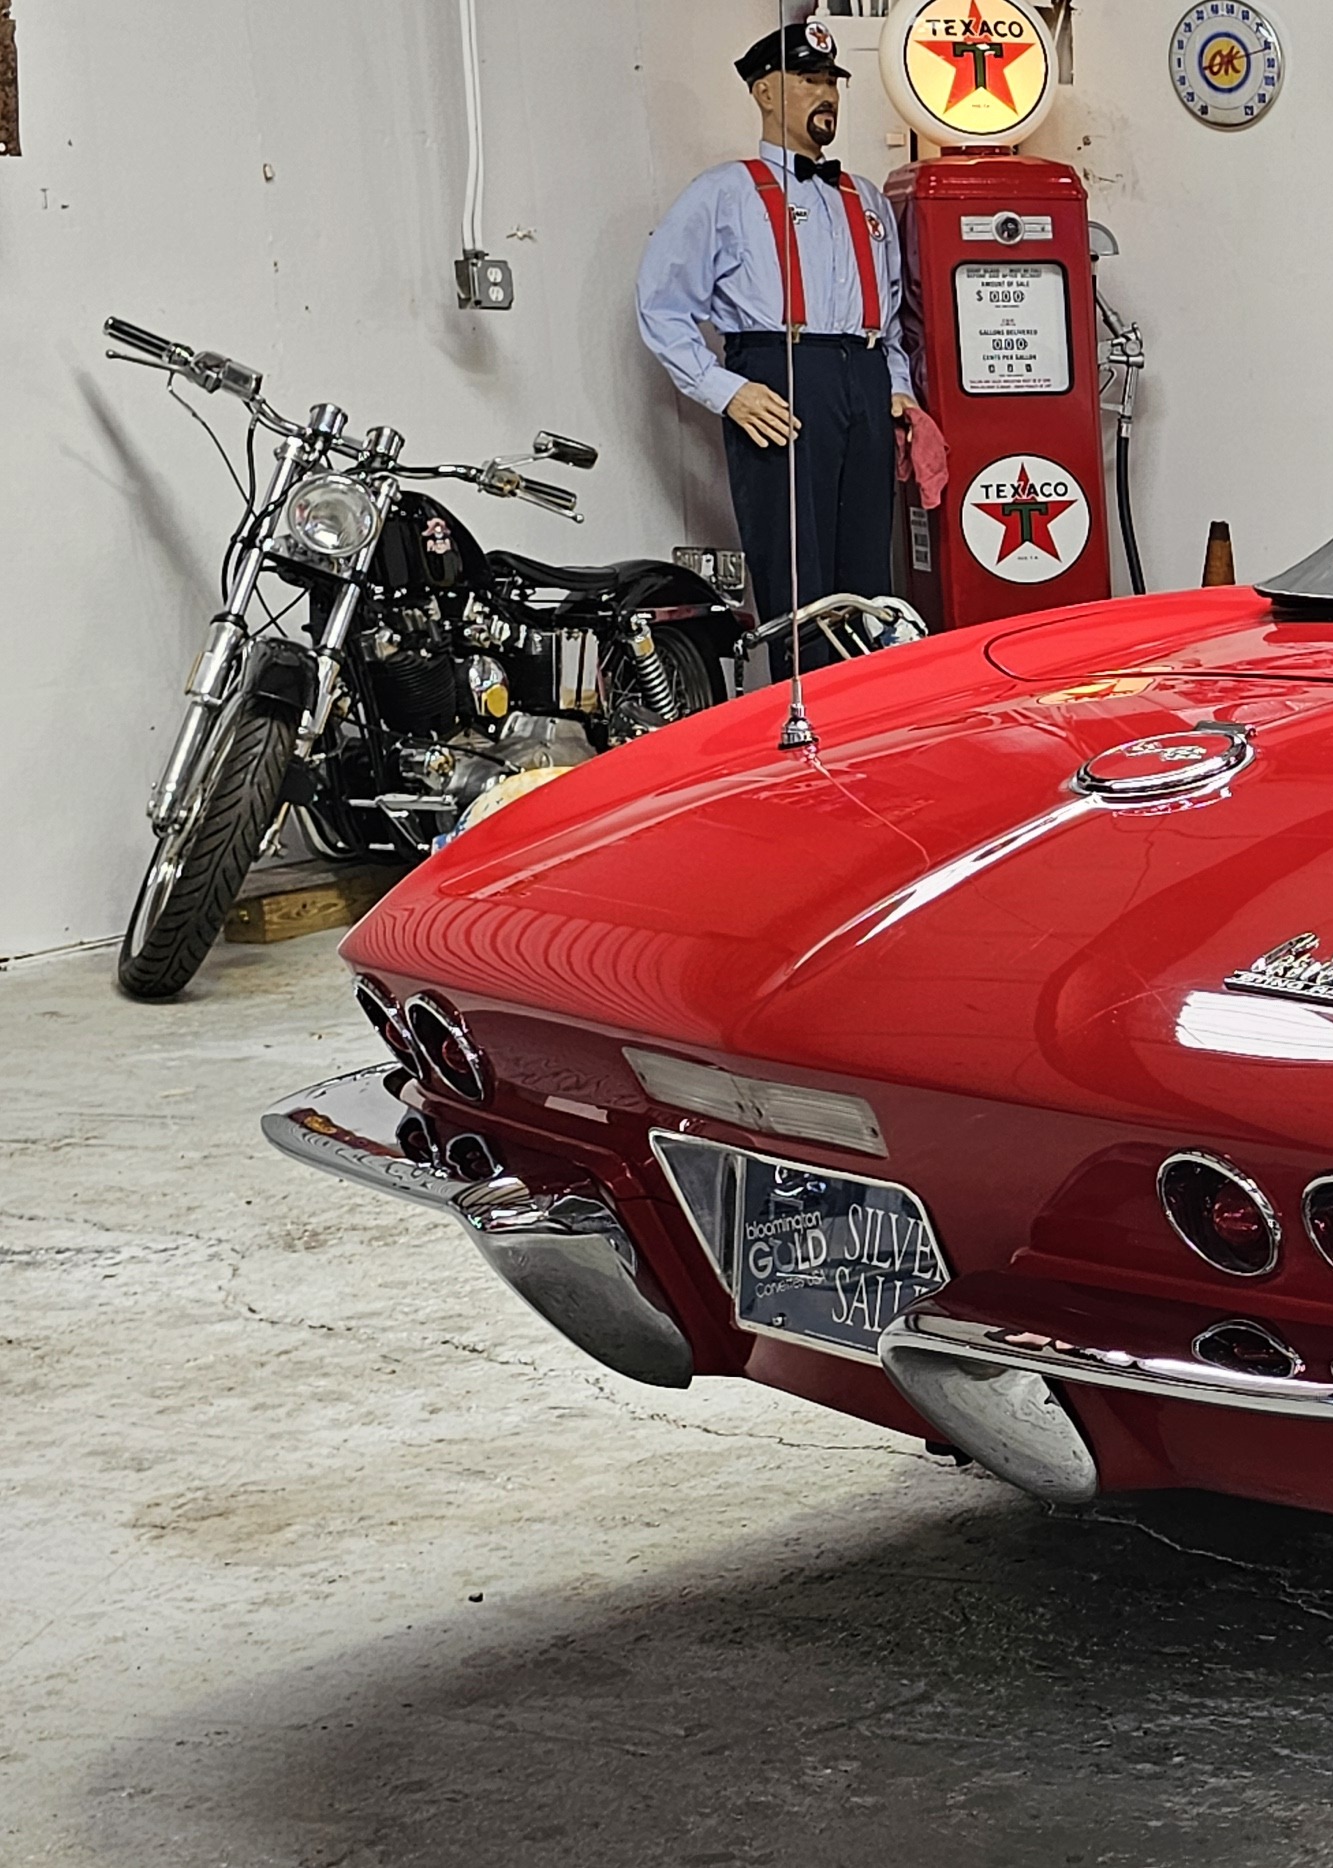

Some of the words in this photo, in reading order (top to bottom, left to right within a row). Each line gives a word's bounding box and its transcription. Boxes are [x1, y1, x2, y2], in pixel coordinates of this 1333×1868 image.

[926, 19, 1024, 38] TEXACO
[1208, 45, 1241, 76] OK
[980, 482, 1068, 499] TEXACO
[745, 1212, 822, 1240] bloomington
[749, 1229, 827, 1279] GOLD
[831, 1266, 931, 1333] SALL
